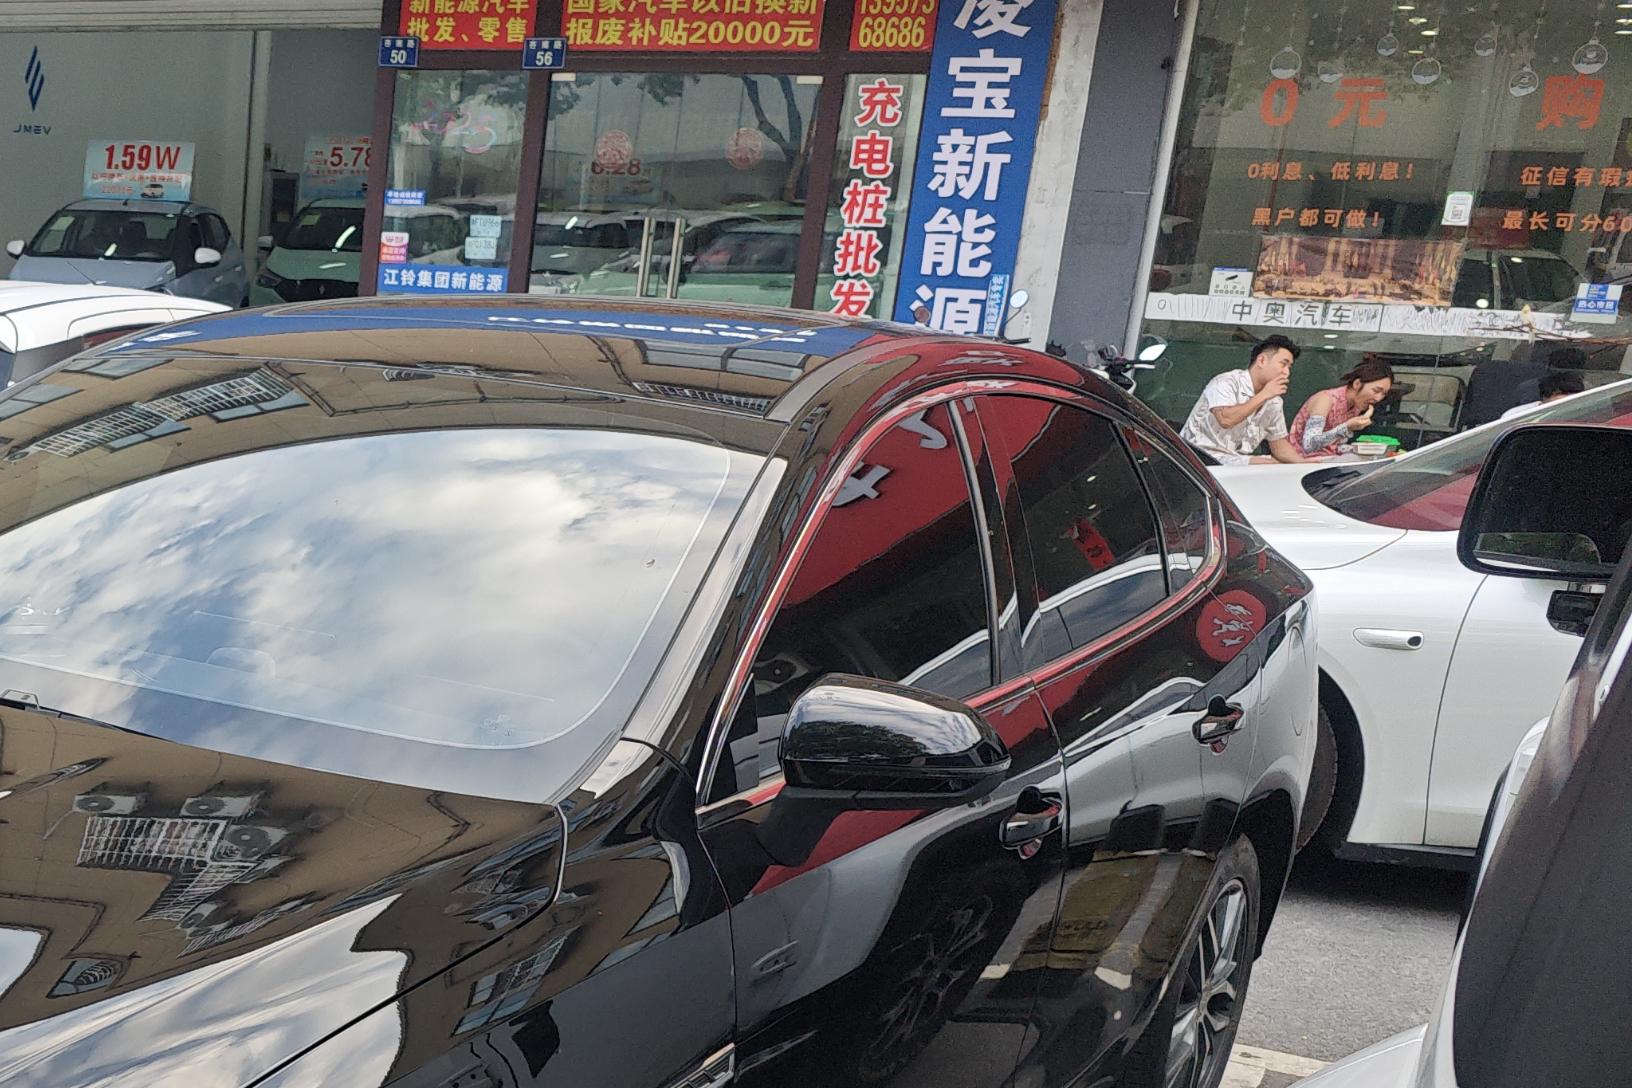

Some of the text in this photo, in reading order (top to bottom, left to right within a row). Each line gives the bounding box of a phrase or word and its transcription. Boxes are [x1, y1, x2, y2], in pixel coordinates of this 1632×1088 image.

[406, 17, 528, 43] 批发、零售
[565, 18, 815, 47] 报废补贴20000元
[858, 16, 926, 48] 68686
[390, 49, 407, 64] 50
[535, 51, 554, 66] 56
[13, 124, 52, 135] JMEV
[828, 77, 904, 319] 充电桩批发
[383, 268, 504, 292] 江铃集团新能源
[1231, 300, 1355, 327] 中奥汽车
